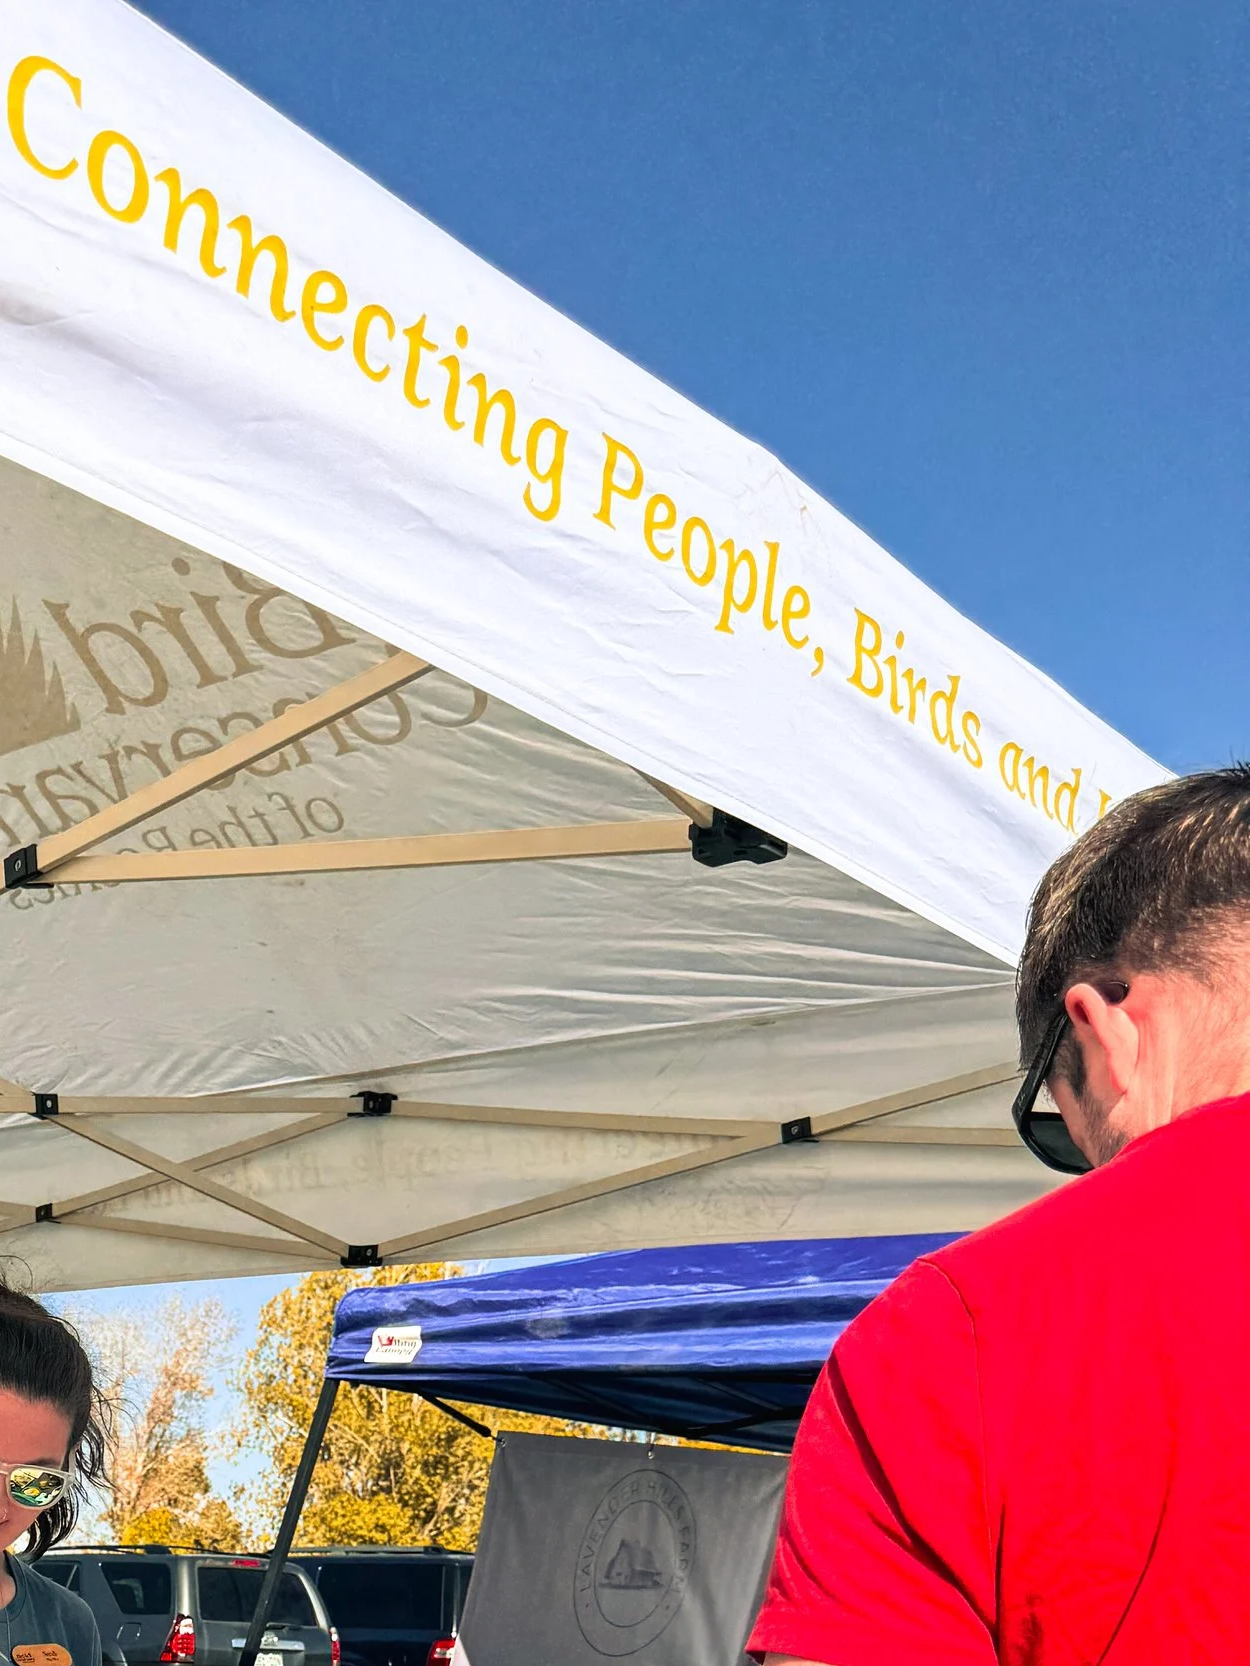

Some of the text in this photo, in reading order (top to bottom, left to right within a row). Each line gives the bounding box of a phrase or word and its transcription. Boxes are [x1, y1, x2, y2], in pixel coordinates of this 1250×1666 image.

[7, 55, 1082, 837] Connecting People, Birds and
